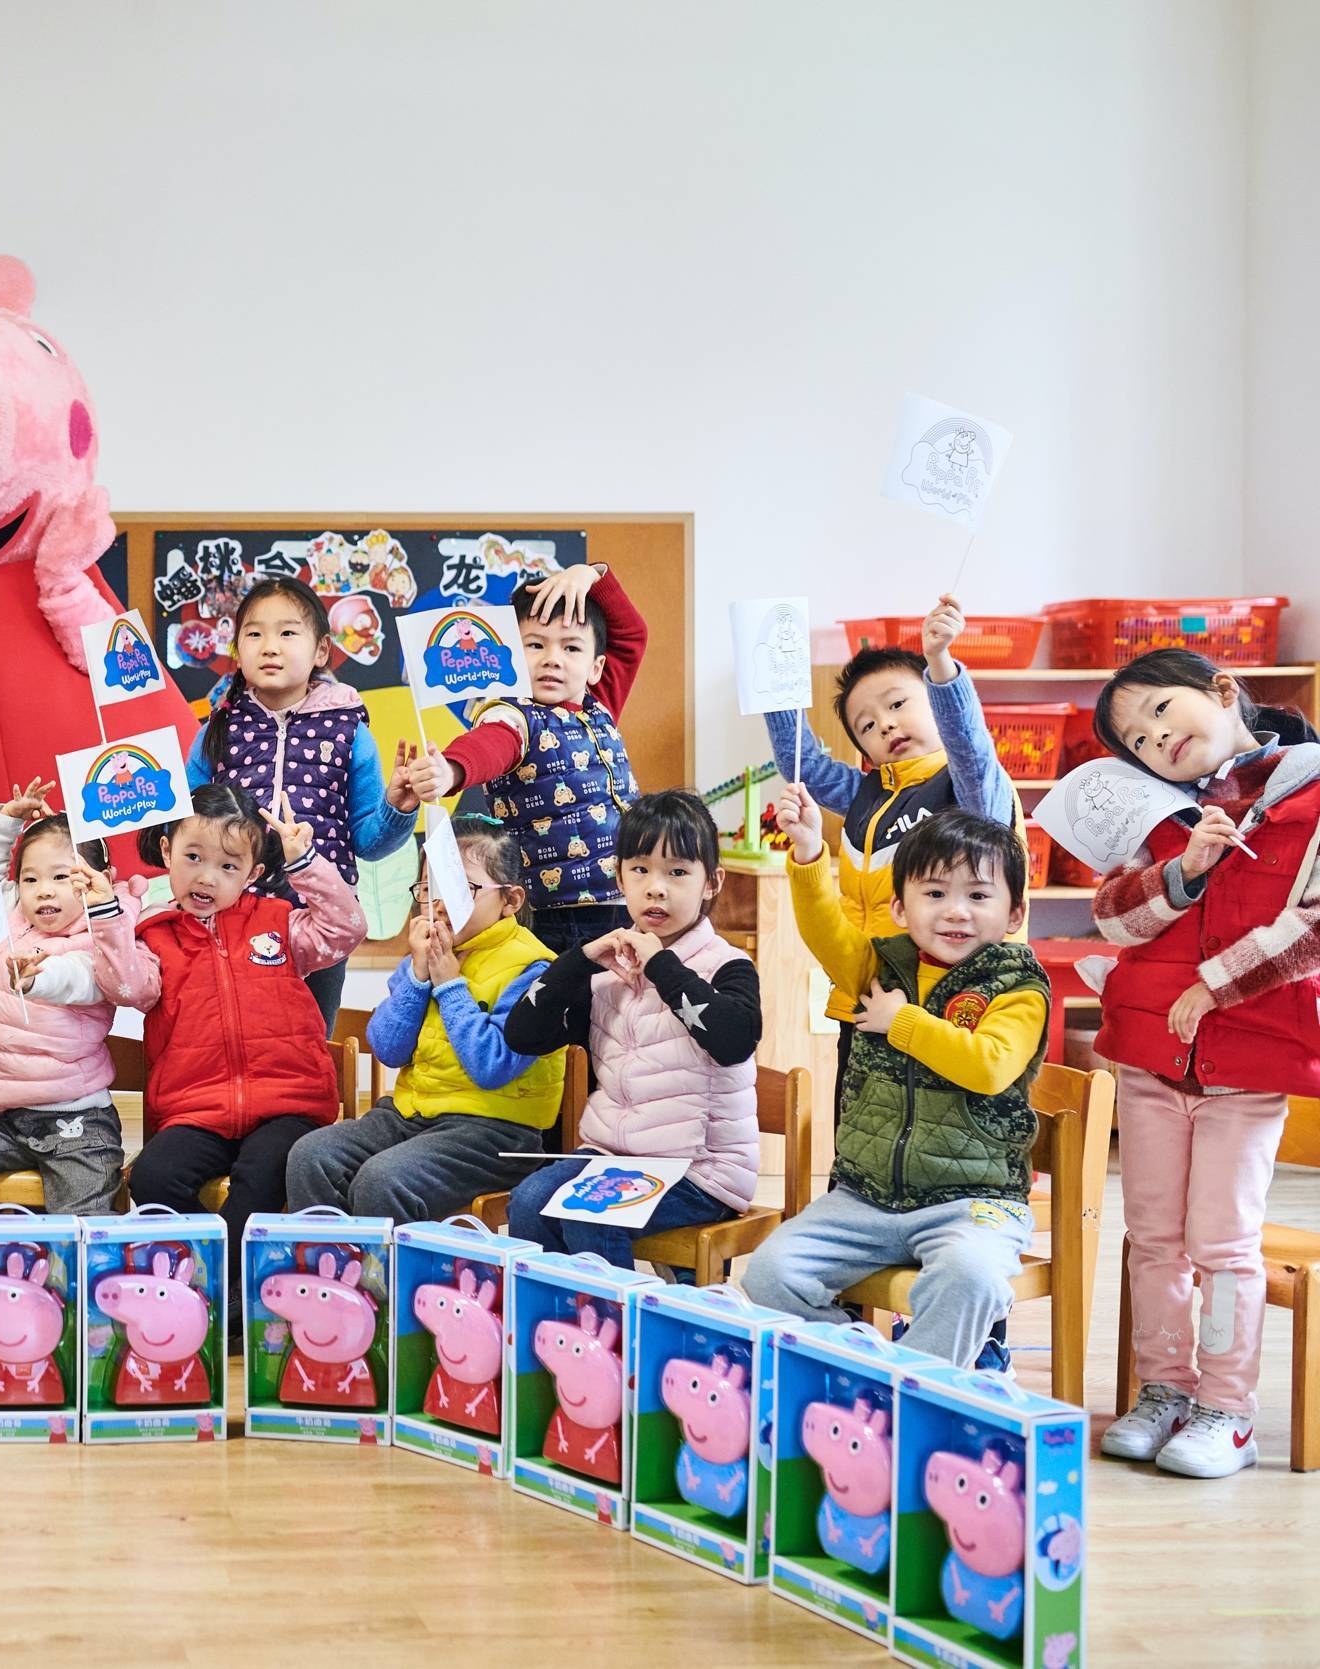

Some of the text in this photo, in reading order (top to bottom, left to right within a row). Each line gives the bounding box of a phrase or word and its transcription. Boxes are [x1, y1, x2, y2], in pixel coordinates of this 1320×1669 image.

[117, 648, 149, 673] Peppa Pig
[441, 646, 499, 672] Peppa Pig
[121, 673, 139, 685] World
[140, 669, 151, 679] Play
[445, 672, 477, 685] World
[481, 670, 500, 680] Play
[98, 776, 156, 808] Peppa Pig
[101, 804, 132, 820] World
[136, 800, 157, 812] Play
[1085, 806, 1124, 838] Peppa
[886, 807, 934, 839] FILA
